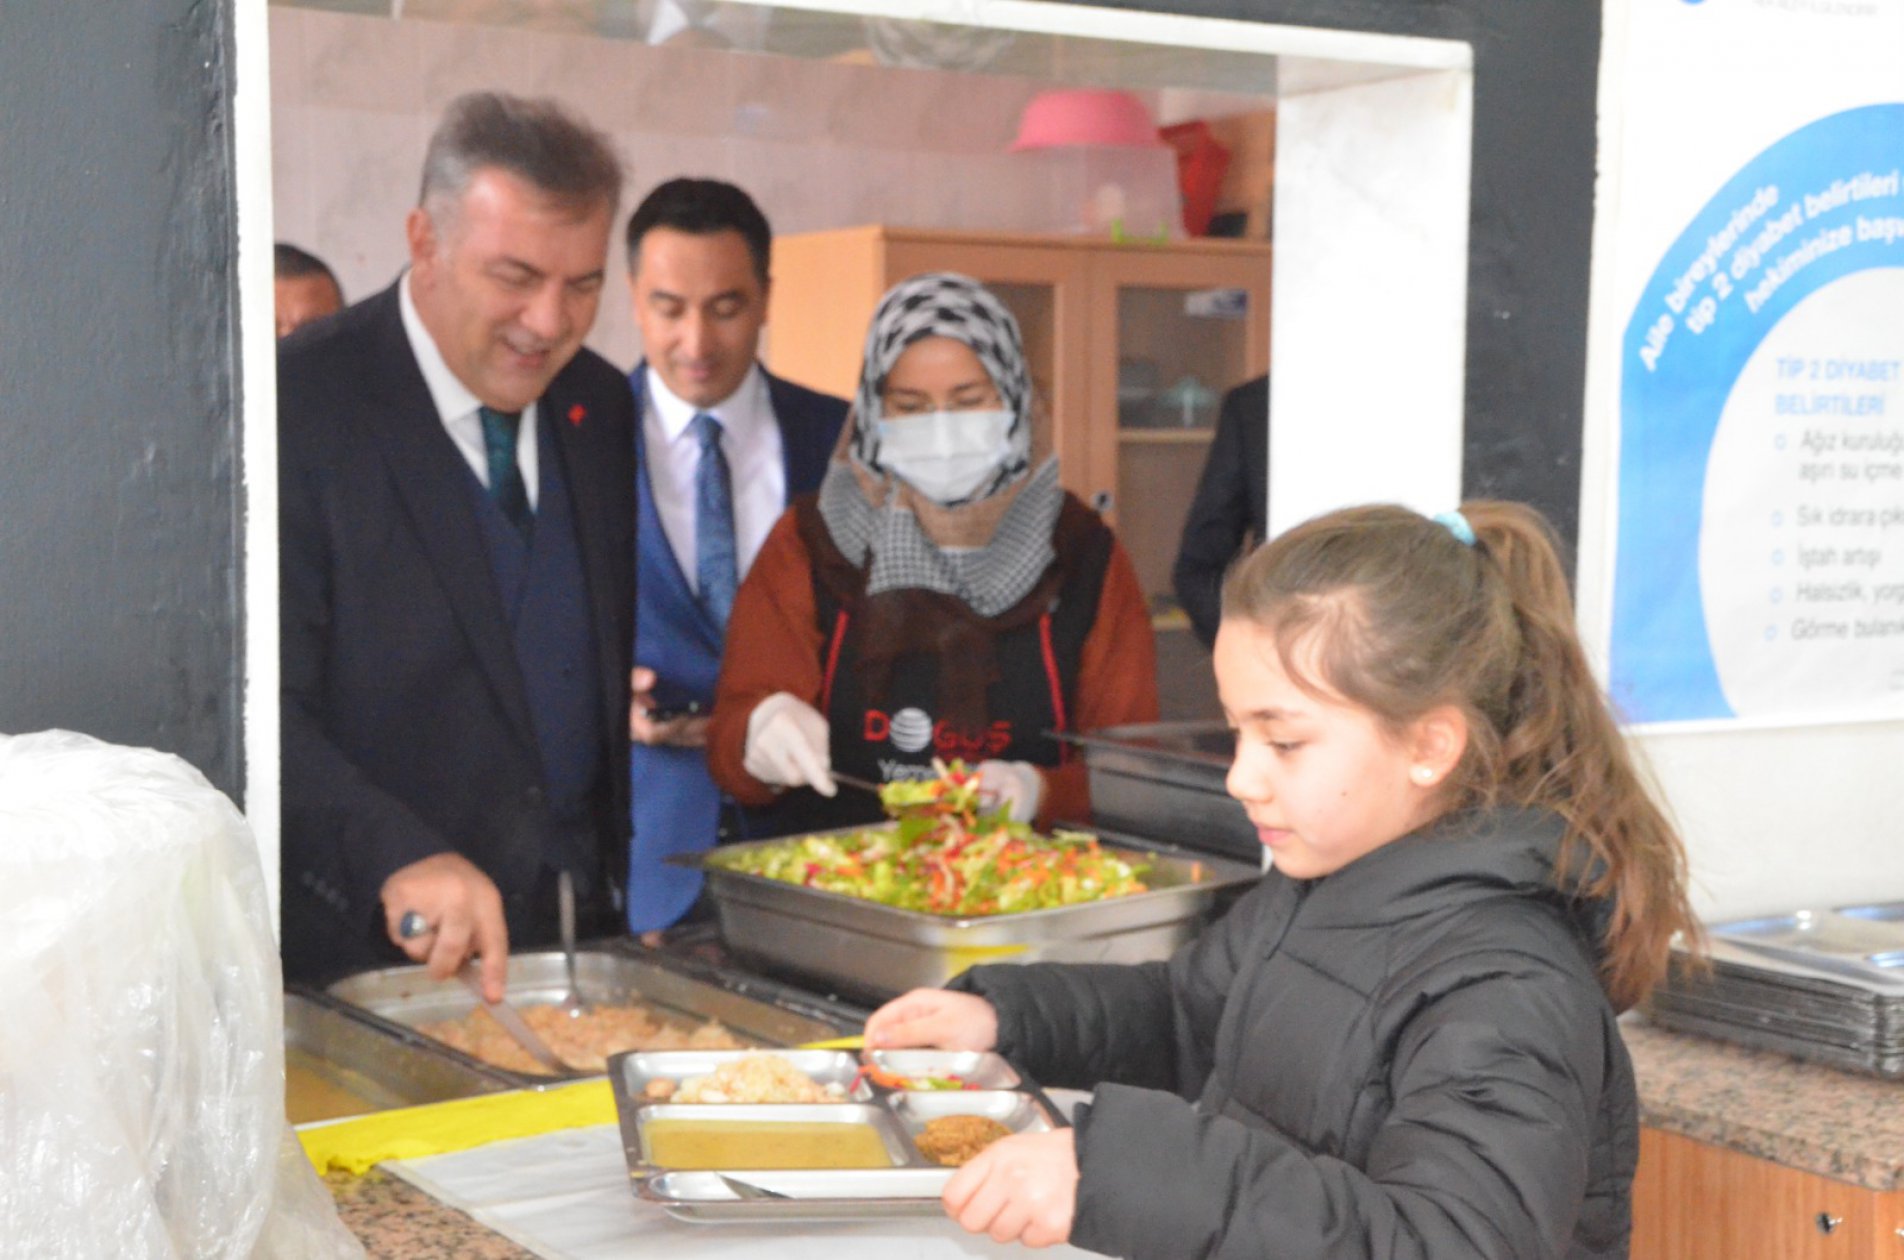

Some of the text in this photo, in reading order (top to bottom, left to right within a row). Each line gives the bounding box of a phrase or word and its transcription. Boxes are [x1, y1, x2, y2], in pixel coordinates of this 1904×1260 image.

[1638, 184, 1779, 372] Aile bireylerinde
[1685, 168, 1900, 334] tip 2 diyabet belirtileri
[1743, 224, 1853, 314] hekiminize
[1809, 358, 1821, 381] 2
[1824, 356, 1902, 382] DİYABET
